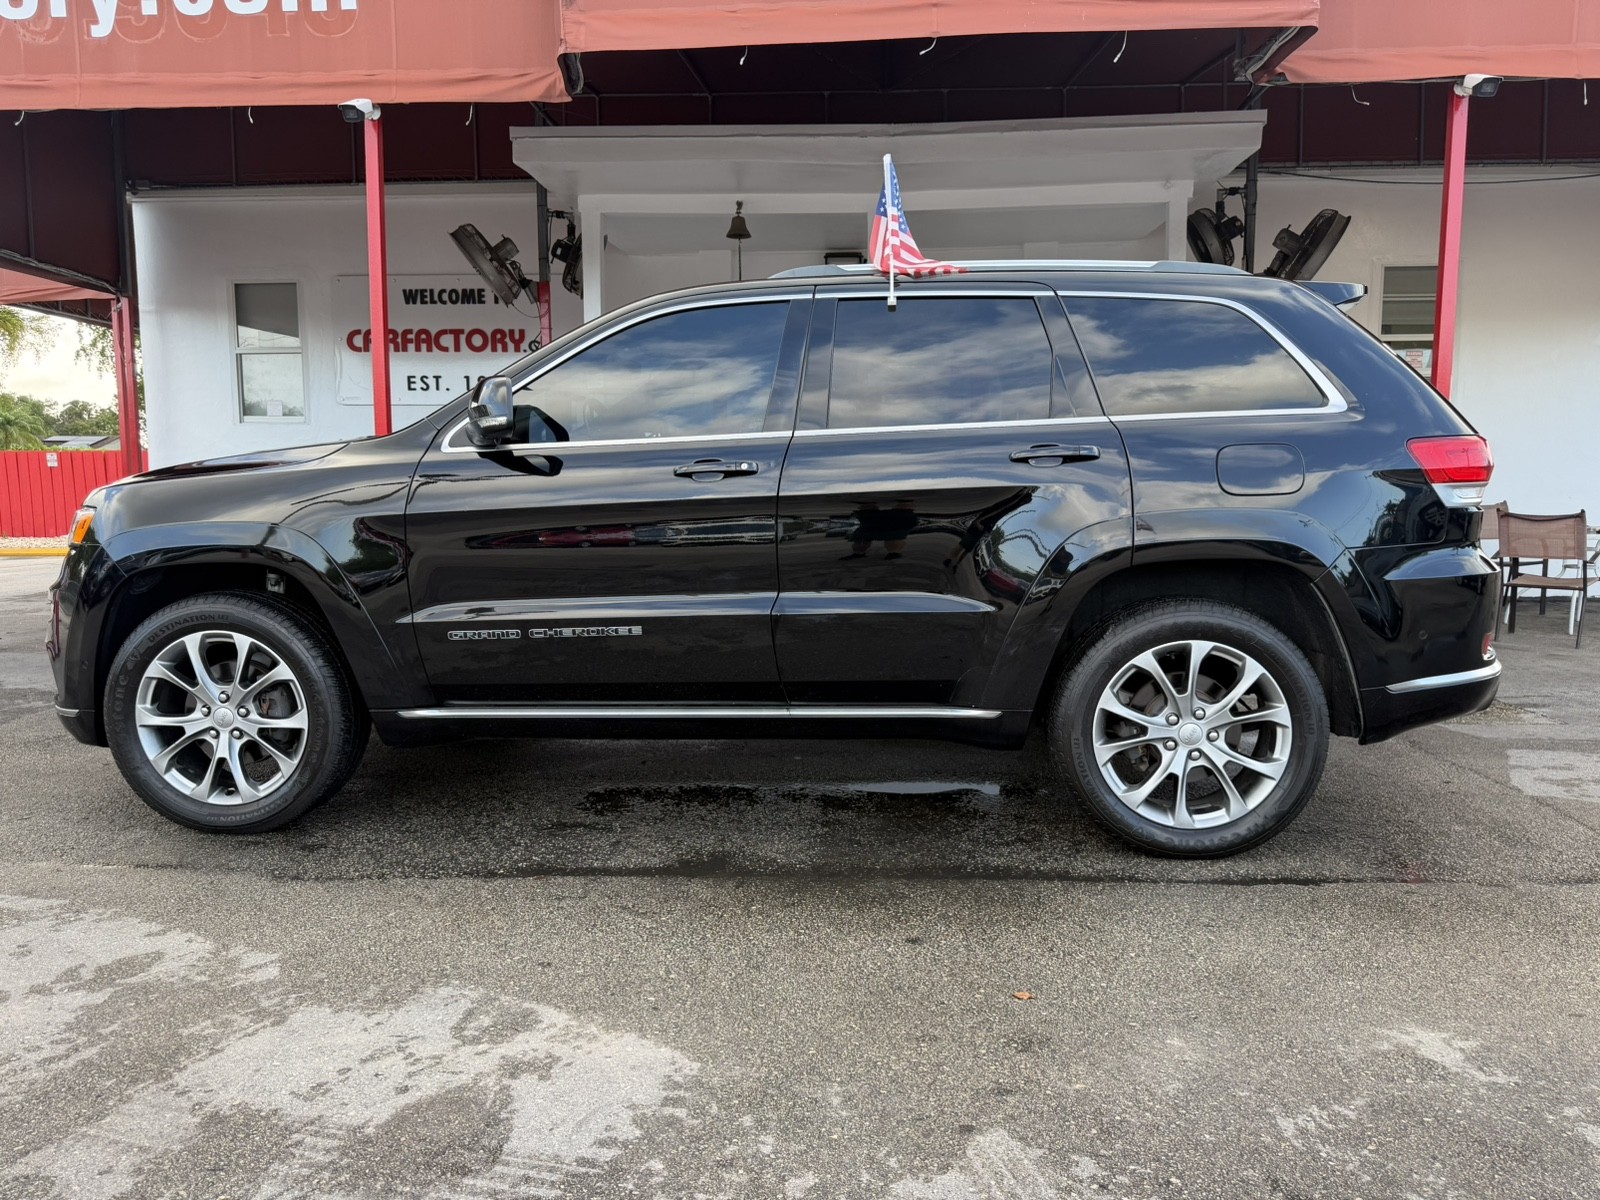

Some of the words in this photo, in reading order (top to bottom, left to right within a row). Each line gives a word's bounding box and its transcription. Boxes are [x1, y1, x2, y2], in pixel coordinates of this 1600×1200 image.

[402, 288, 486, 305] WELCOME
[406, 375, 450, 391] EST.
[148, 614, 215, 643] DESTINATION
[447, 629, 522, 640] GRAND
[528, 625, 643, 639] CHEROKEE
